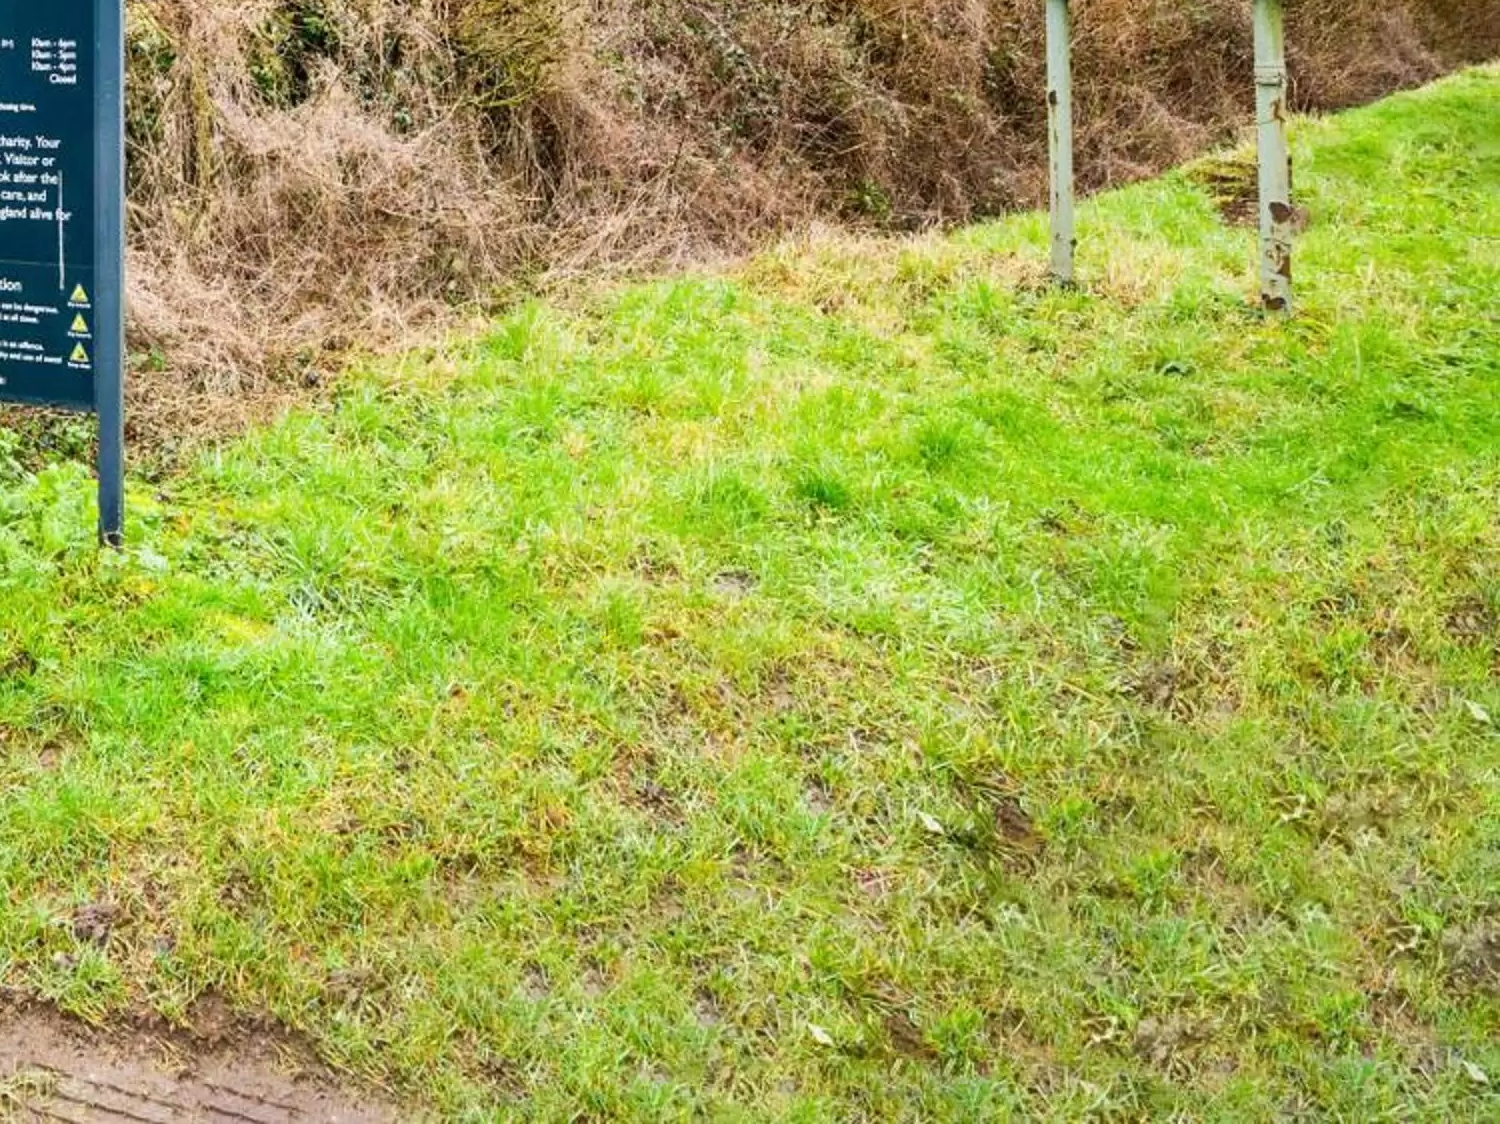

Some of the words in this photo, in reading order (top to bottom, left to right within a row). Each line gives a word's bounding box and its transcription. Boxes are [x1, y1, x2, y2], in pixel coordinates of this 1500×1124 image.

[49, 73, 76, 84] Closed
[35, 135, 61, 149] Your
[3, 152, 40, 166] Visitor
[41, 157, 55, 167] or
[13, 171, 37, 184] after
[40, 172, 58, 185] the
[0, 190, 26, 202] care,
[27, 189, 47, 202] and
[29, 207, 52, 220] alive
[55, 207, 72, 221] for
